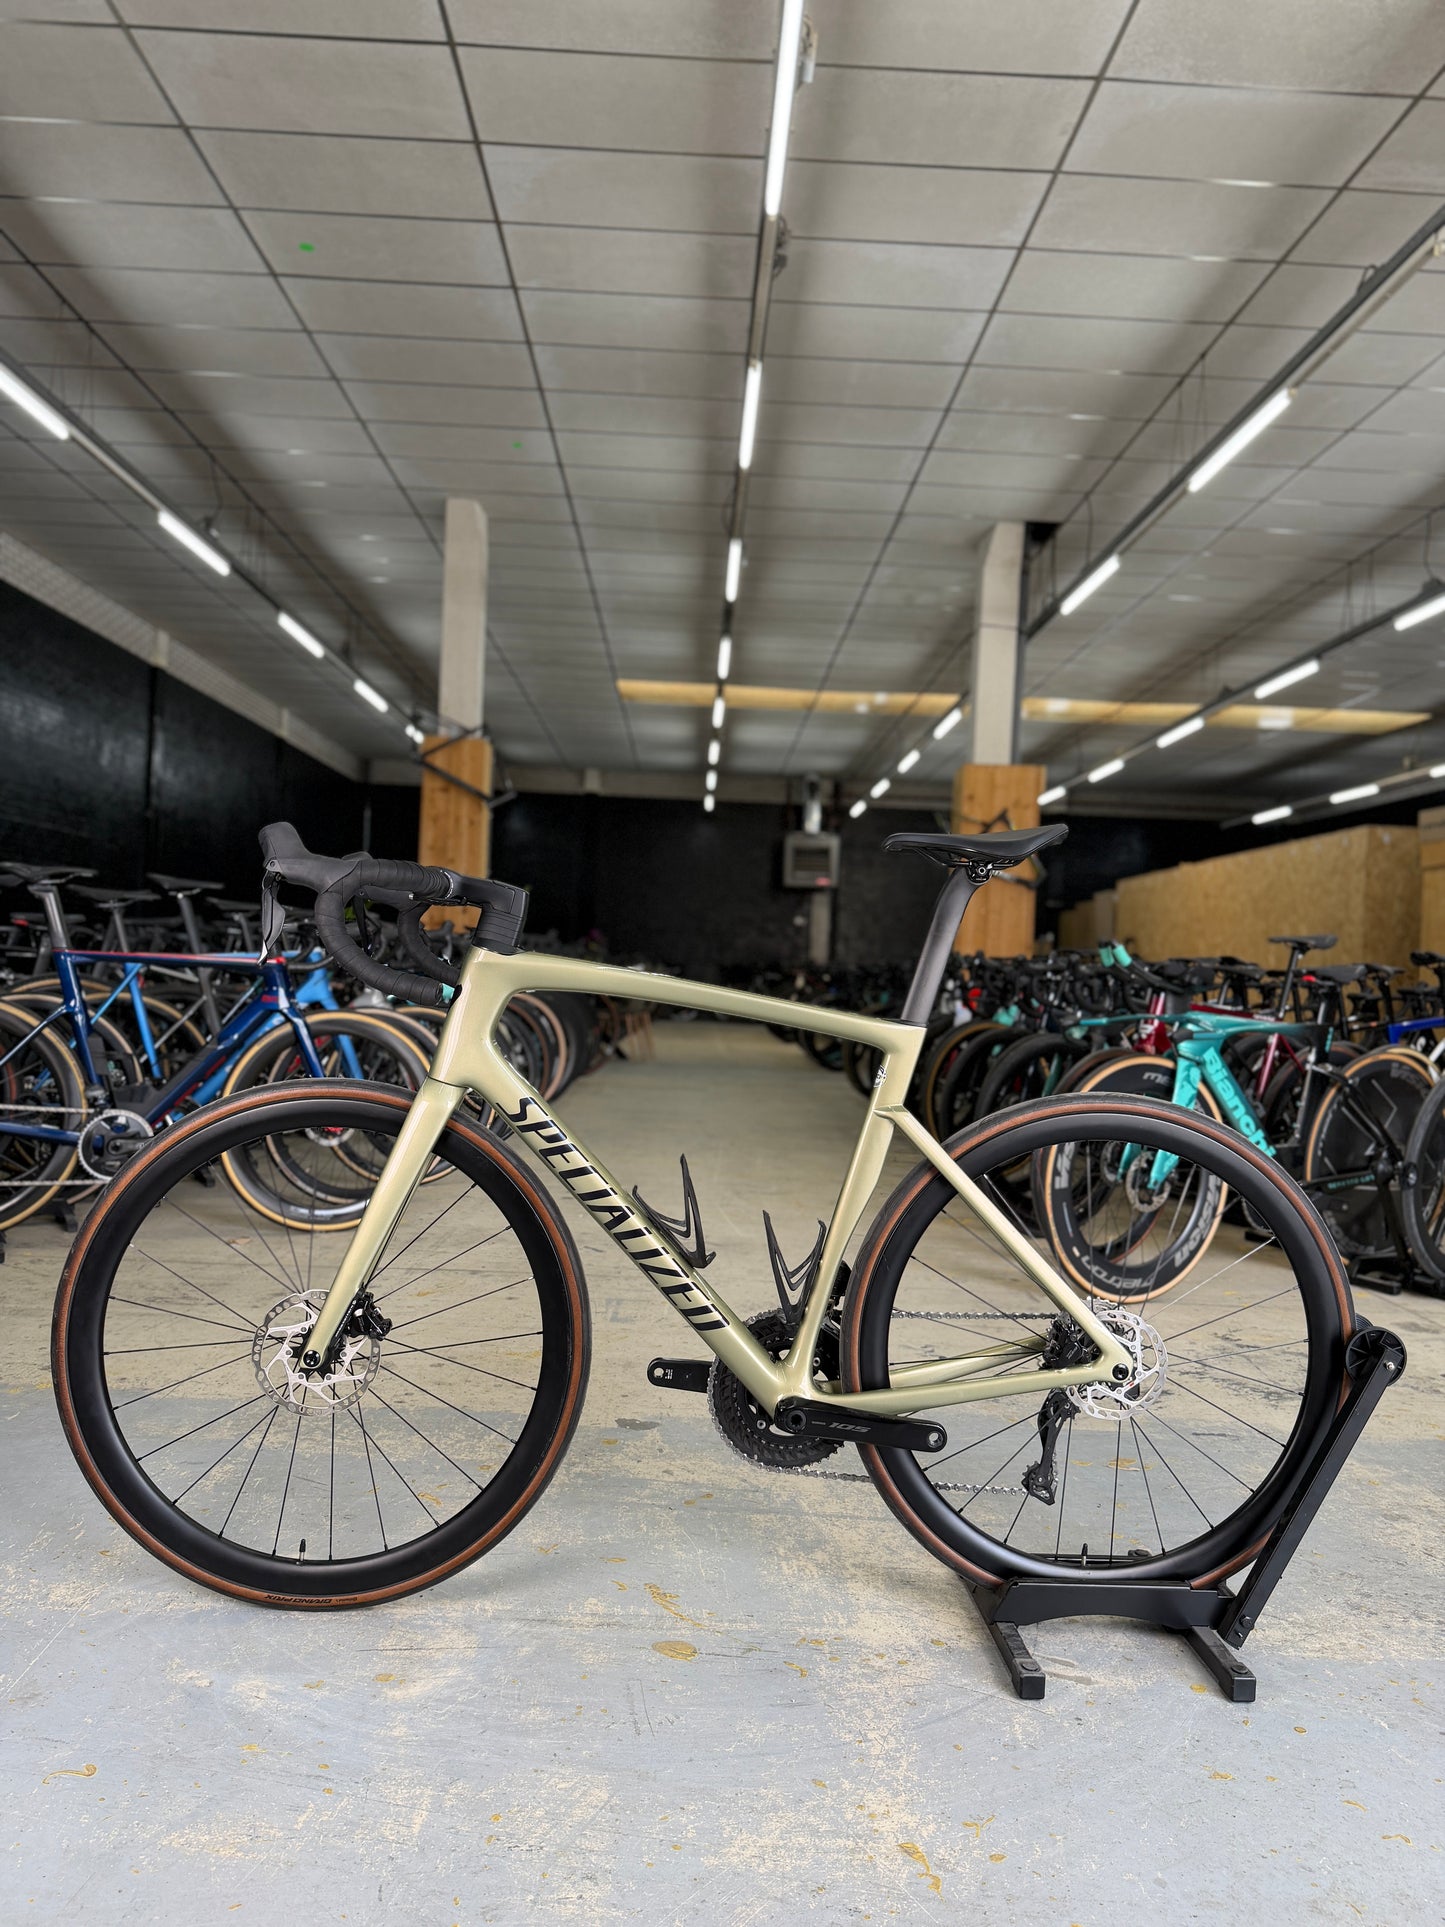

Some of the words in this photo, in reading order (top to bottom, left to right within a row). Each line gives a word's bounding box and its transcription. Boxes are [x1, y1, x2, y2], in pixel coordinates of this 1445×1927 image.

[1202, 1046, 1277, 1158] Bianchi
[495, 1096, 730, 1332] SPECIALIZED
[828, 1422, 872, 1434] 105
[264, 1594, 294, 1603] PRIX
